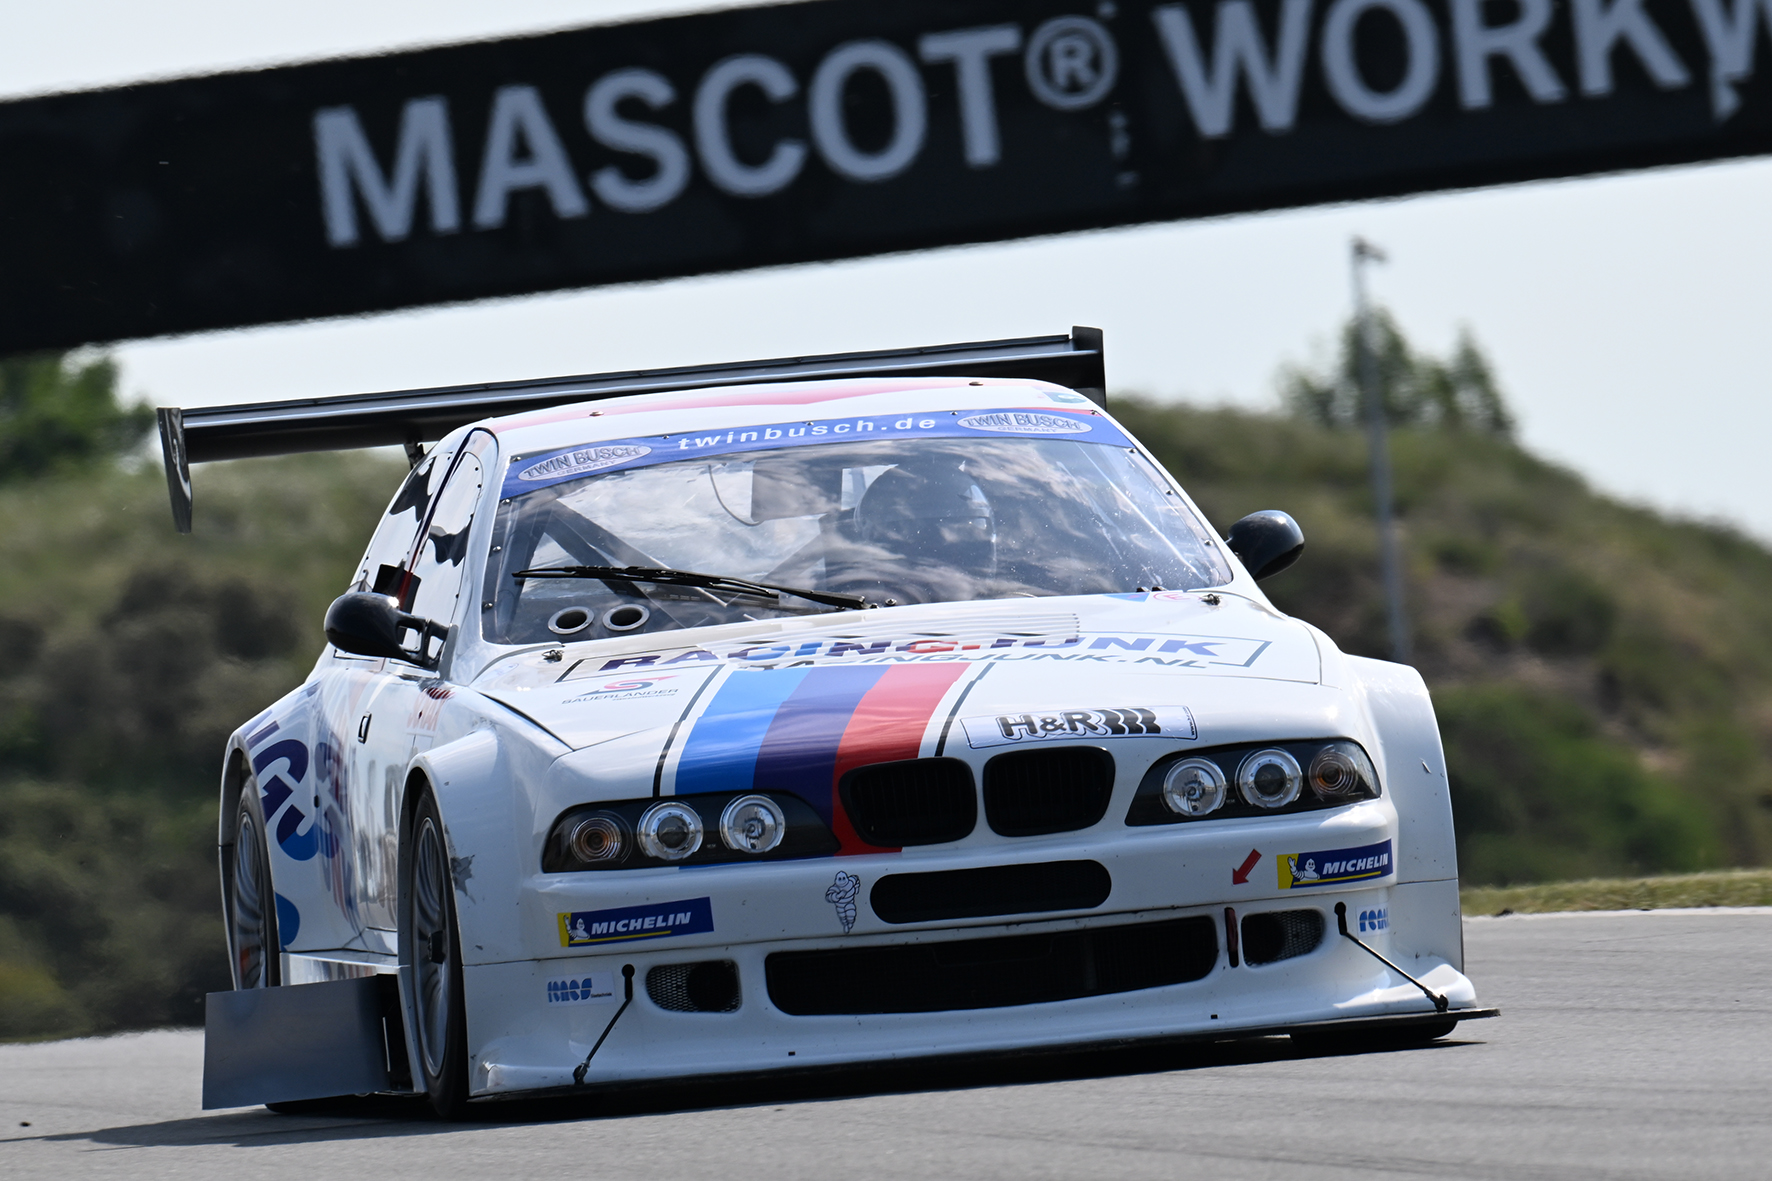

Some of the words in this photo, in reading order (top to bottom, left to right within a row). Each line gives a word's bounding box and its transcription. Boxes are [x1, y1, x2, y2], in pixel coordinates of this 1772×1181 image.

[678, 417, 936, 450] twinbusch.de
[964, 413, 1012, 427] TWIN
[1014, 413, 1081, 430] BUSCH
[523, 455, 571, 478] TWIN
[574, 445, 642, 466] BUSCH
[557, 460, 616, 476] GERMANY
[998, 711, 1102, 738] H&R
[1322, 852, 1389, 875] MICHELIN
[590, 911, 692, 935] MICHELIN
